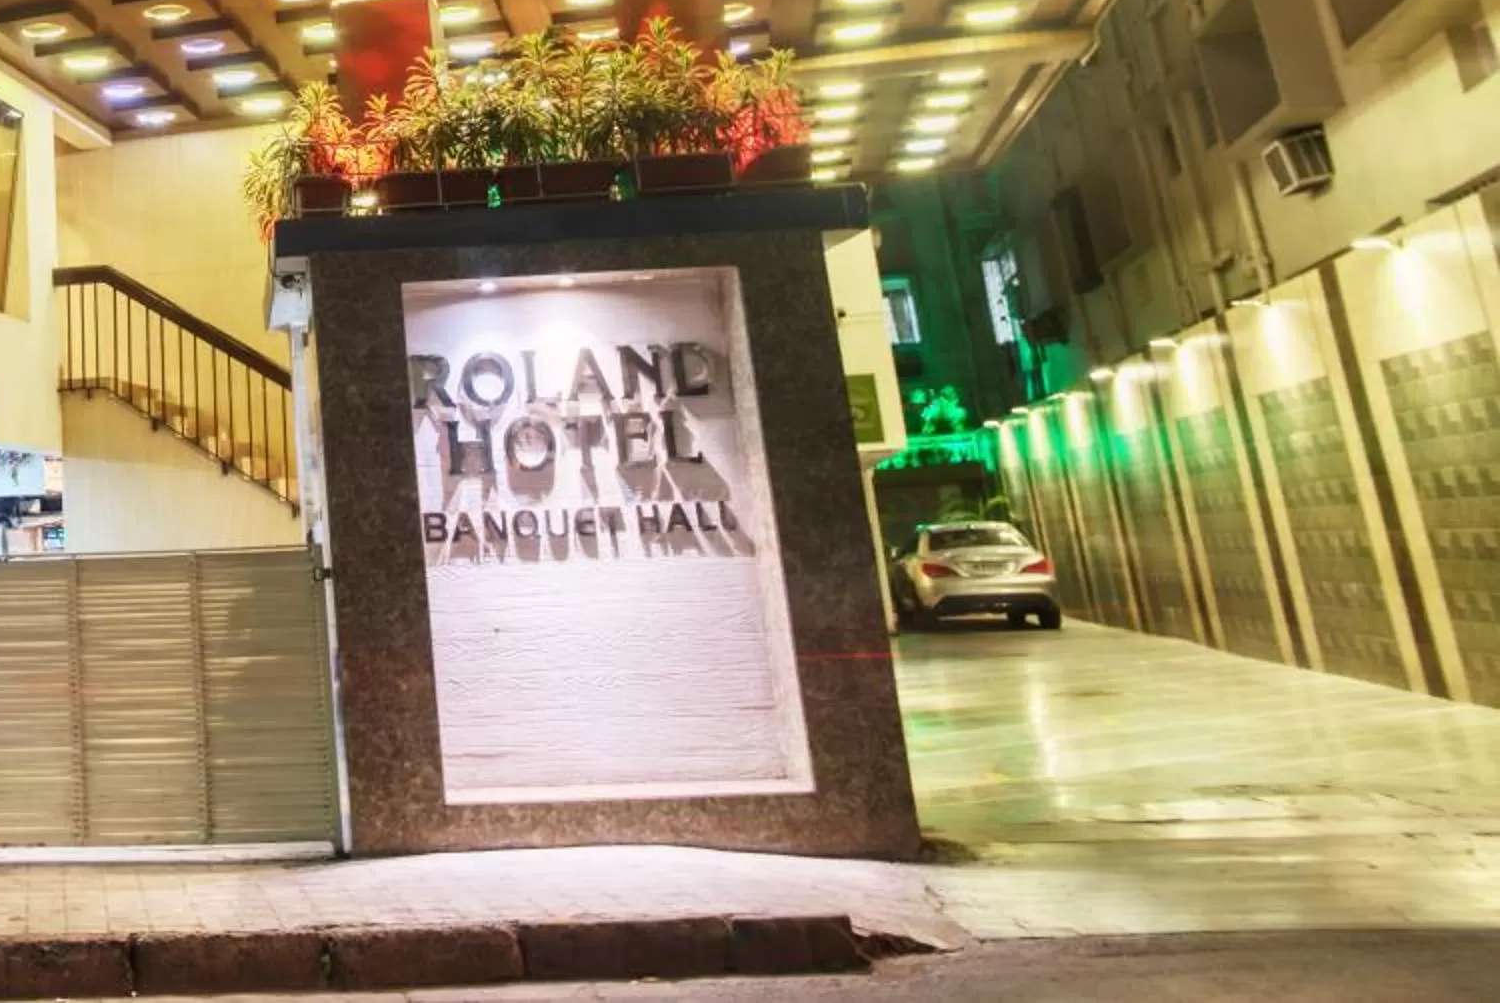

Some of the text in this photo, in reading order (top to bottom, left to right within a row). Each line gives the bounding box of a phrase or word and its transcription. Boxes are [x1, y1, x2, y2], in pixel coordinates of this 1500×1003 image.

[409, 342, 710, 409] ROLAND
[444, 409, 705, 475] HOTEL
[422, 500, 739, 543] BANQUET HALL
